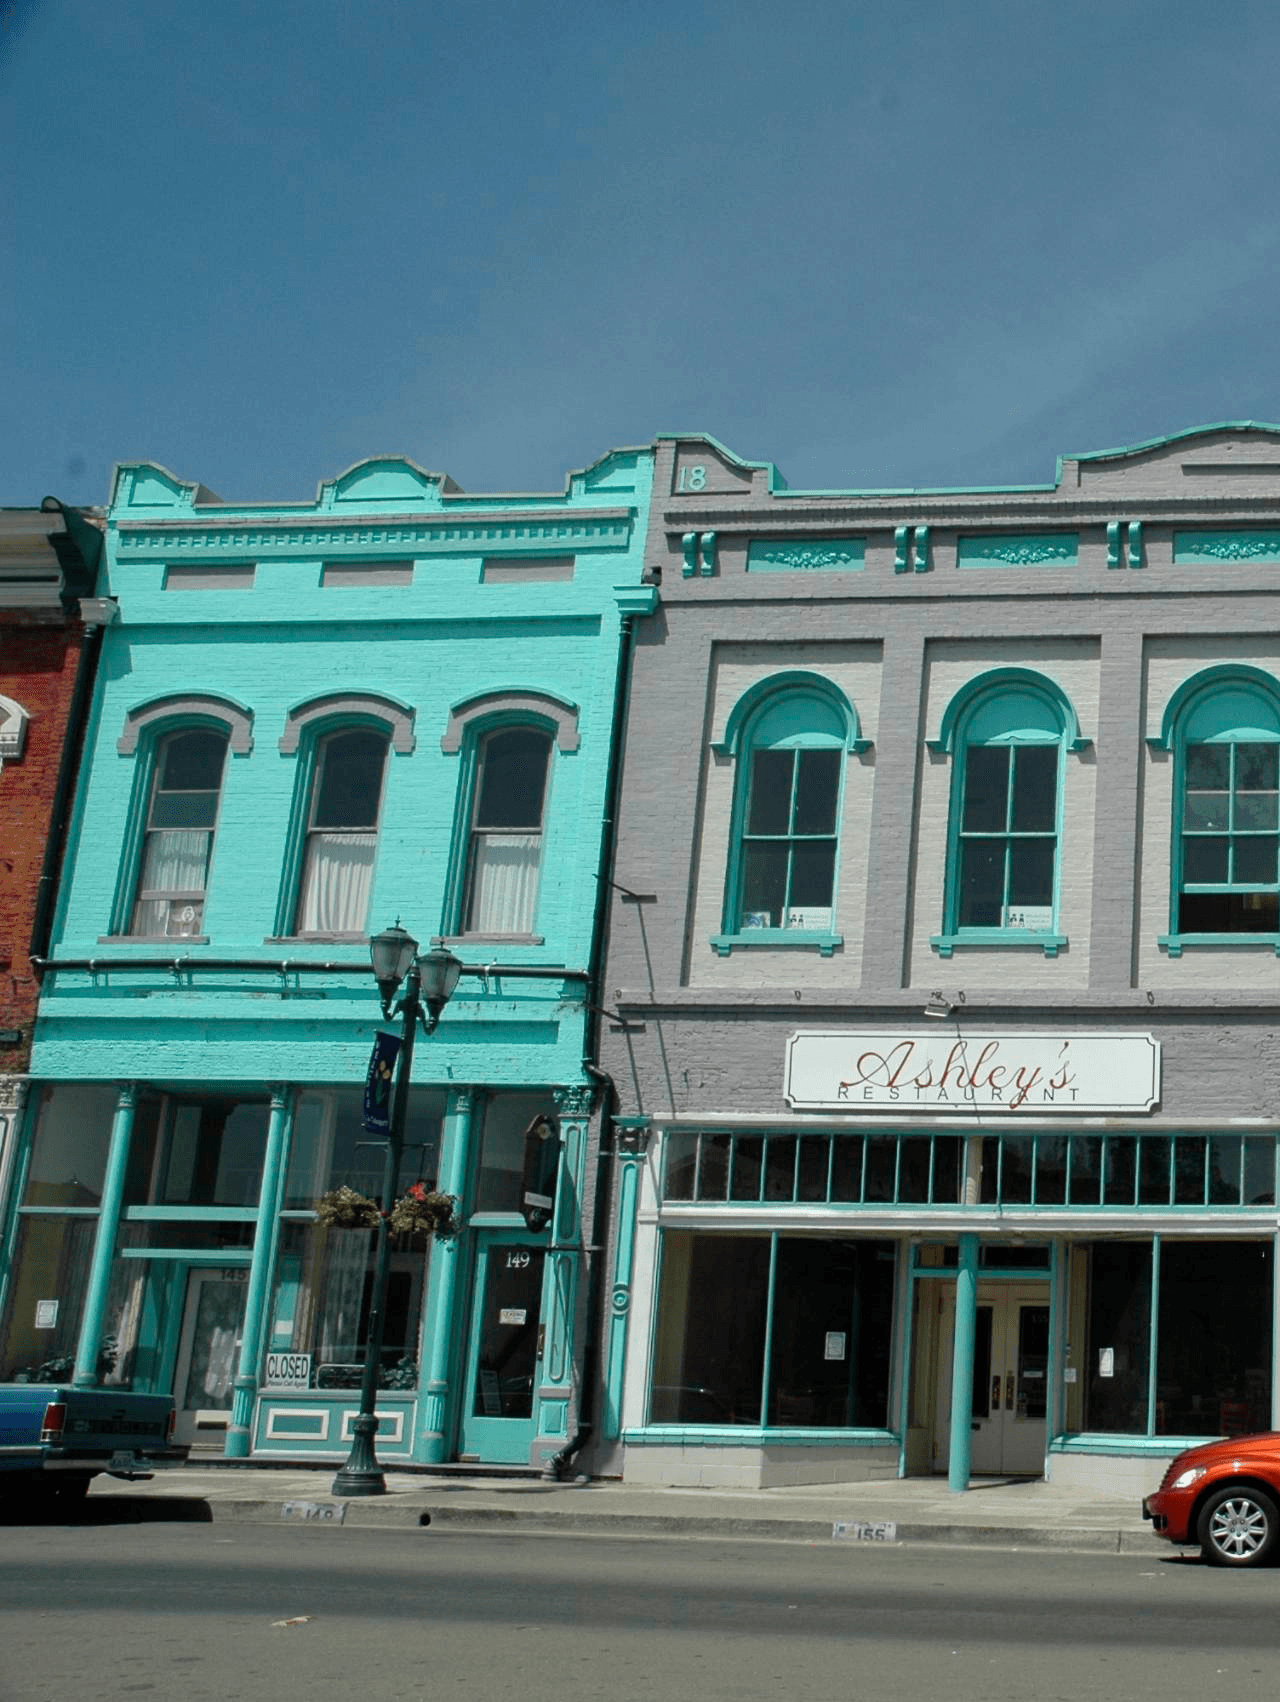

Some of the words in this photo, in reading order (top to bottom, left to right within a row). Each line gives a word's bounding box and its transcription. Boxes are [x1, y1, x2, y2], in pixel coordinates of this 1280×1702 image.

[679, 465, 706, 492] 18
[840, 1041, 1076, 1109] Ashley's
[837, 1086, 1080, 1101] RESTAURANT
[505, 1252, 530, 1268] 149
[267, 1356, 308, 1378] CLOSED
[857, 1527, 885, 1540] 155
